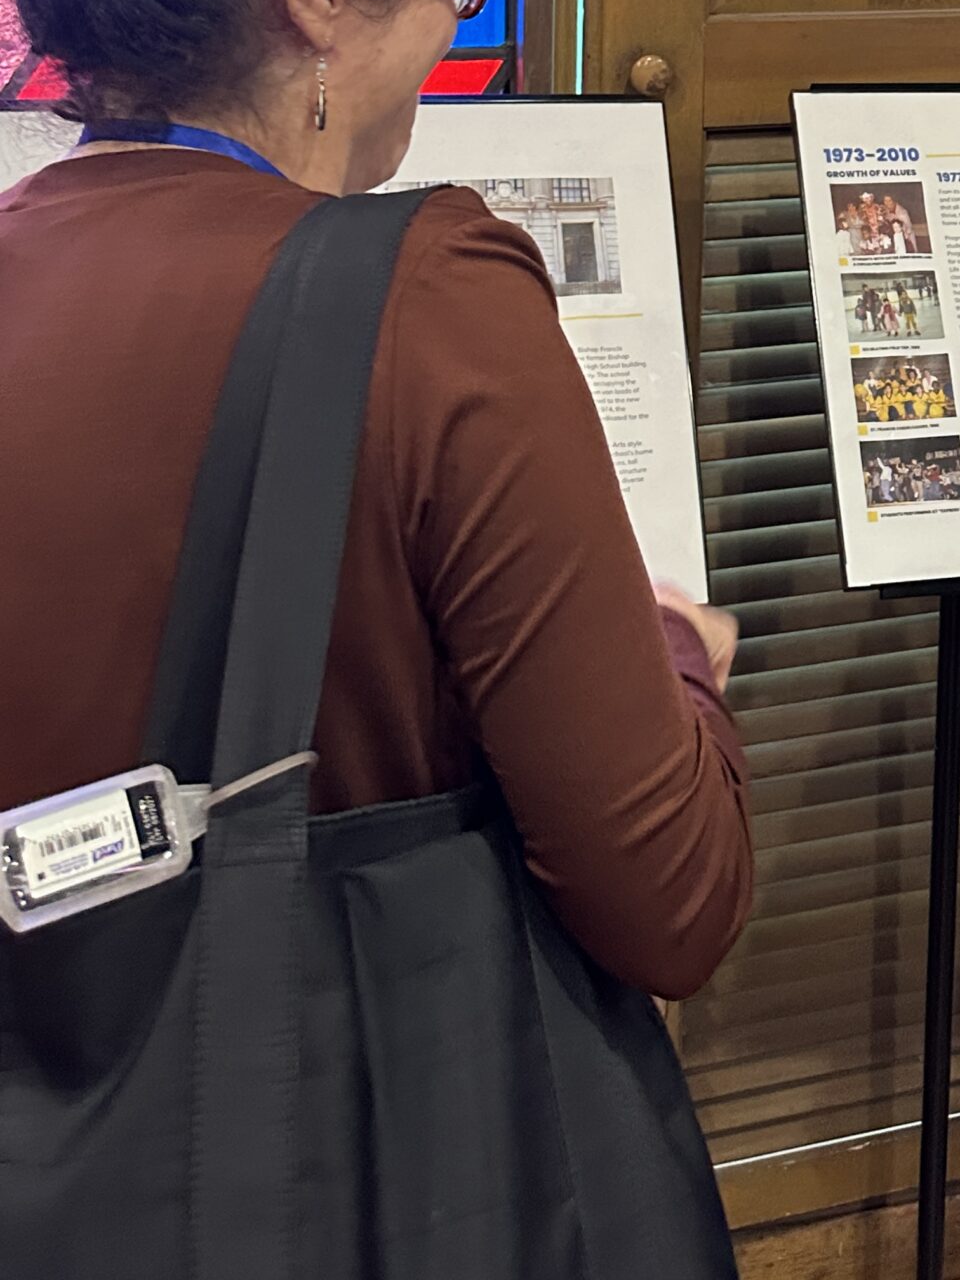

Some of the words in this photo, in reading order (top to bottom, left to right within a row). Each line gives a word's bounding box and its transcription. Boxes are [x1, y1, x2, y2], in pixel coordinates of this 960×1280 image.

[826, 170, 868, 178] GROWTH
[869, 169, 880, 177] OF
[883, 169, 917, 177] VALUES
[621, 361, 647, 369] building
